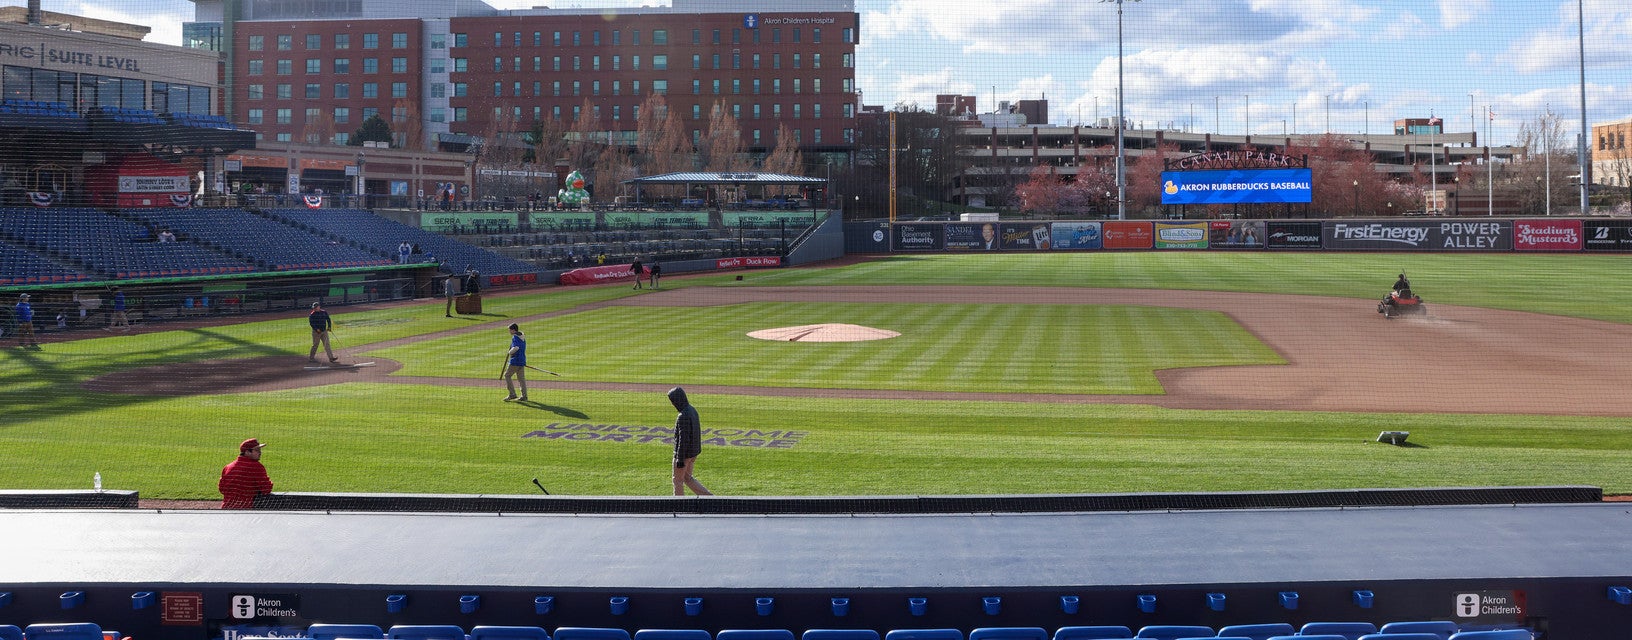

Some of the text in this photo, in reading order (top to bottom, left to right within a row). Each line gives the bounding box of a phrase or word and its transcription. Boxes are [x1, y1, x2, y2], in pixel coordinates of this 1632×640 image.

[811, 17, 835, 25] Hospital
[48, 48, 93, 67] SUITE
[98, 55, 140, 72] LEVEL
[1180, 151, 1291, 169] CANAL PARK
[1211, 182, 1269, 191] RUBBERDUCKS
[1271, 182, 1310, 190] BASEBALL
[434, 217, 461, 225] SERRA
[1334, 223, 1429, 242] FirstEnergy
[1441, 223, 1501, 235] POWER
[1518, 224, 1577, 236] Stadium
[1444, 236, 1498, 248] ALLEY
[1518, 234, 1579, 245] Mustard
[545, 422, 676, 435] UNION
[257, 598, 281, 606] Akron
[1482, 596, 1507, 604] Akron
[257, 608, 297, 617] Children's
[1482, 605, 1522, 614] Children's
